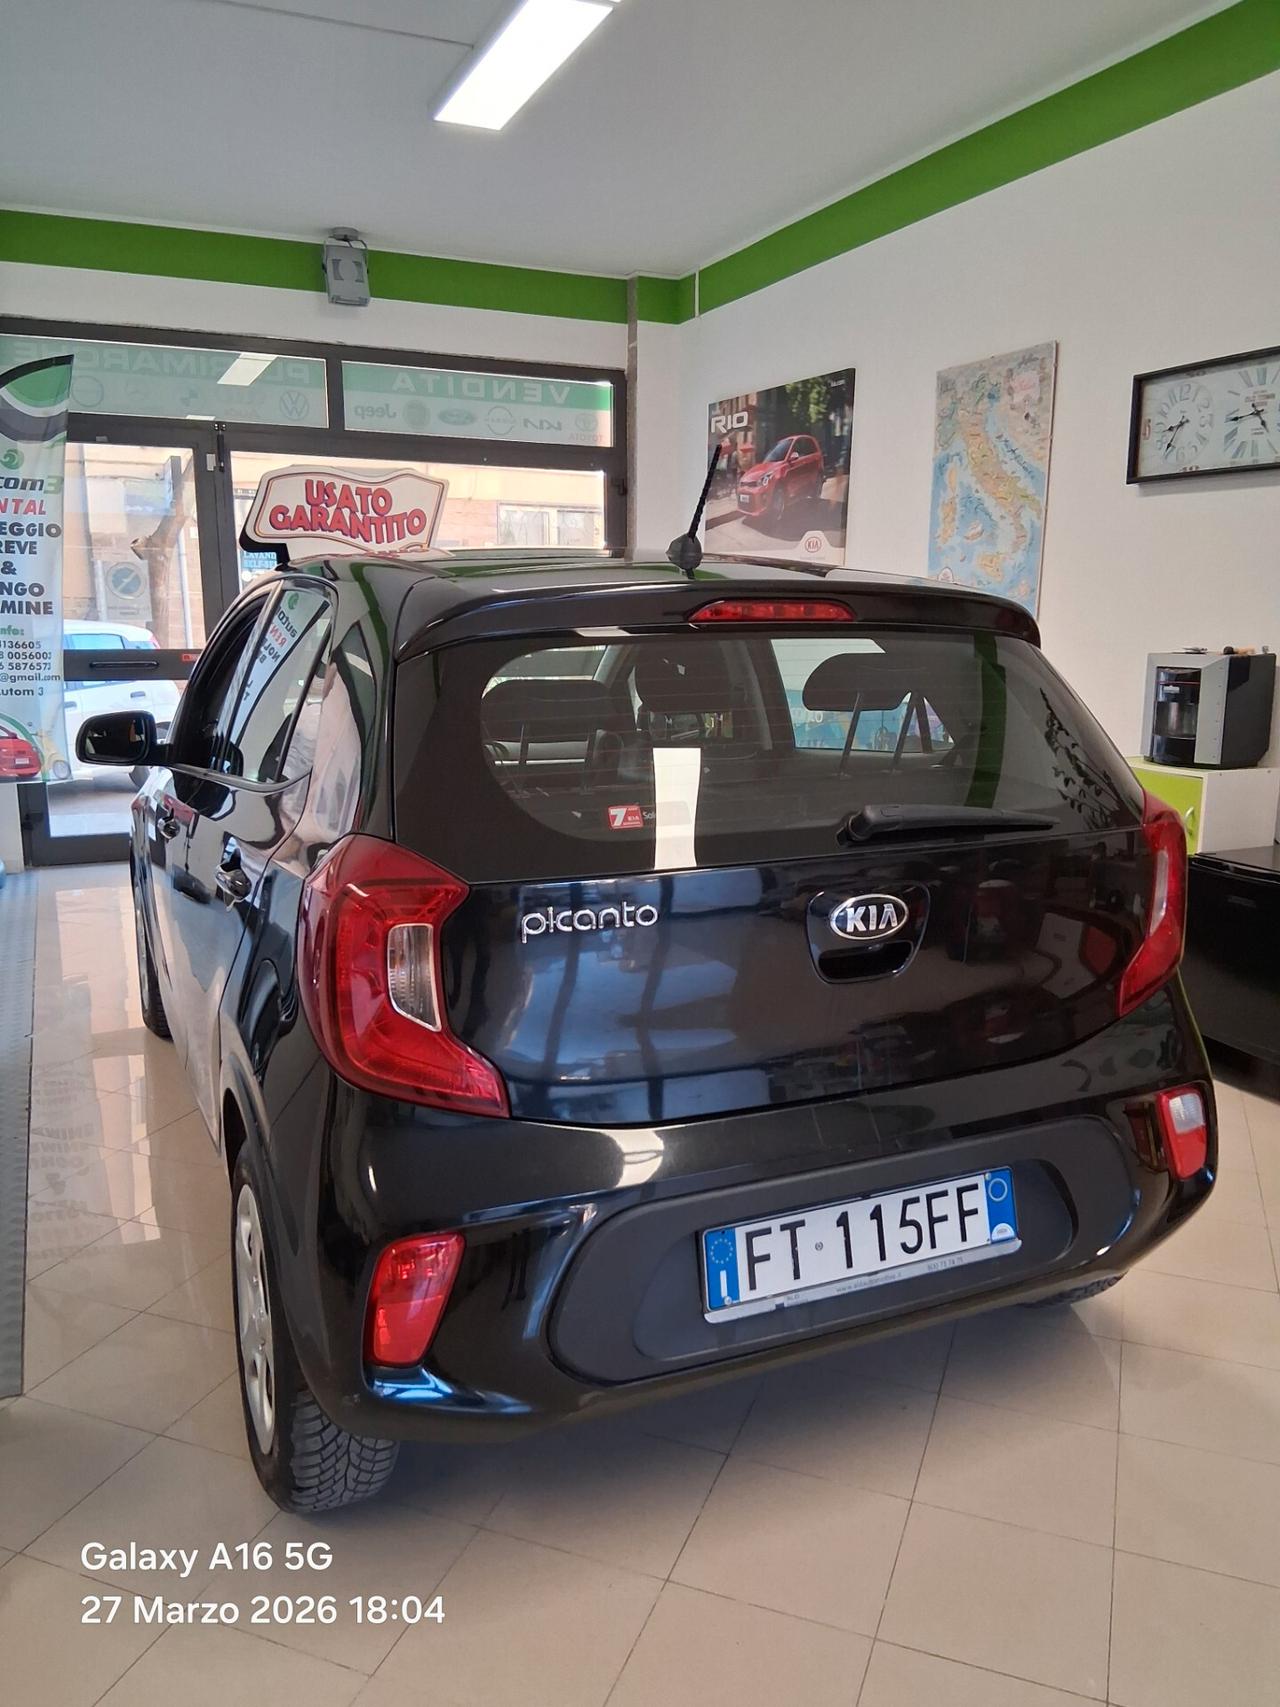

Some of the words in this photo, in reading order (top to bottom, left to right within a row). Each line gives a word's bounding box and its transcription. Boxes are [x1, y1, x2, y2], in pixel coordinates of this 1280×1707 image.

[711, 411, 748, 434] RIO
[305, 479, 393, 516] USATO
[269, 504, 427, 544] GARANTITO
[0, 540, 37, 555] EVE
[1, 561, 17, 575] &
[0, 641, 41, 650] 136605
[0, 687, 35, 697] utom
[611, 808, 627, 827] 7
[521, 901, 659, 943] picanto
[844, 903, 900, 933] KIA
[745, 1219, 806, 1291] FT
[836, 1183, 979, 1270] 115FF
